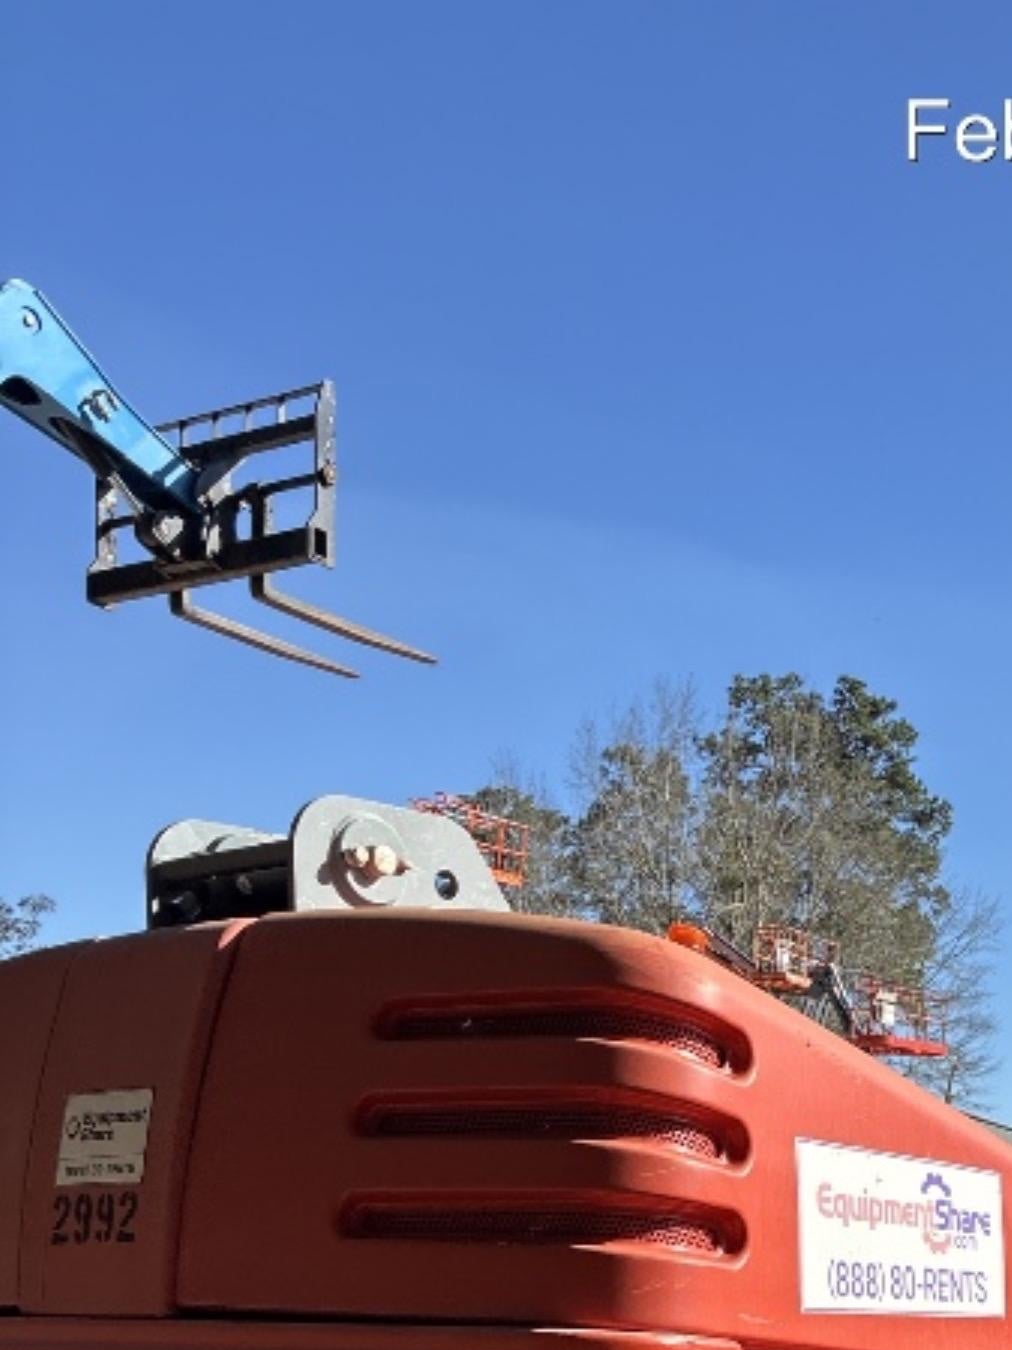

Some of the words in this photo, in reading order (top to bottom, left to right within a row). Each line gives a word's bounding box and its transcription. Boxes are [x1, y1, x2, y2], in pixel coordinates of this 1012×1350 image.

[51, 1191, 138, 1246] 2992
[827, 1259, 886, 1303] (888)
[889, 1265, 988, 1303] 80-RENTS
